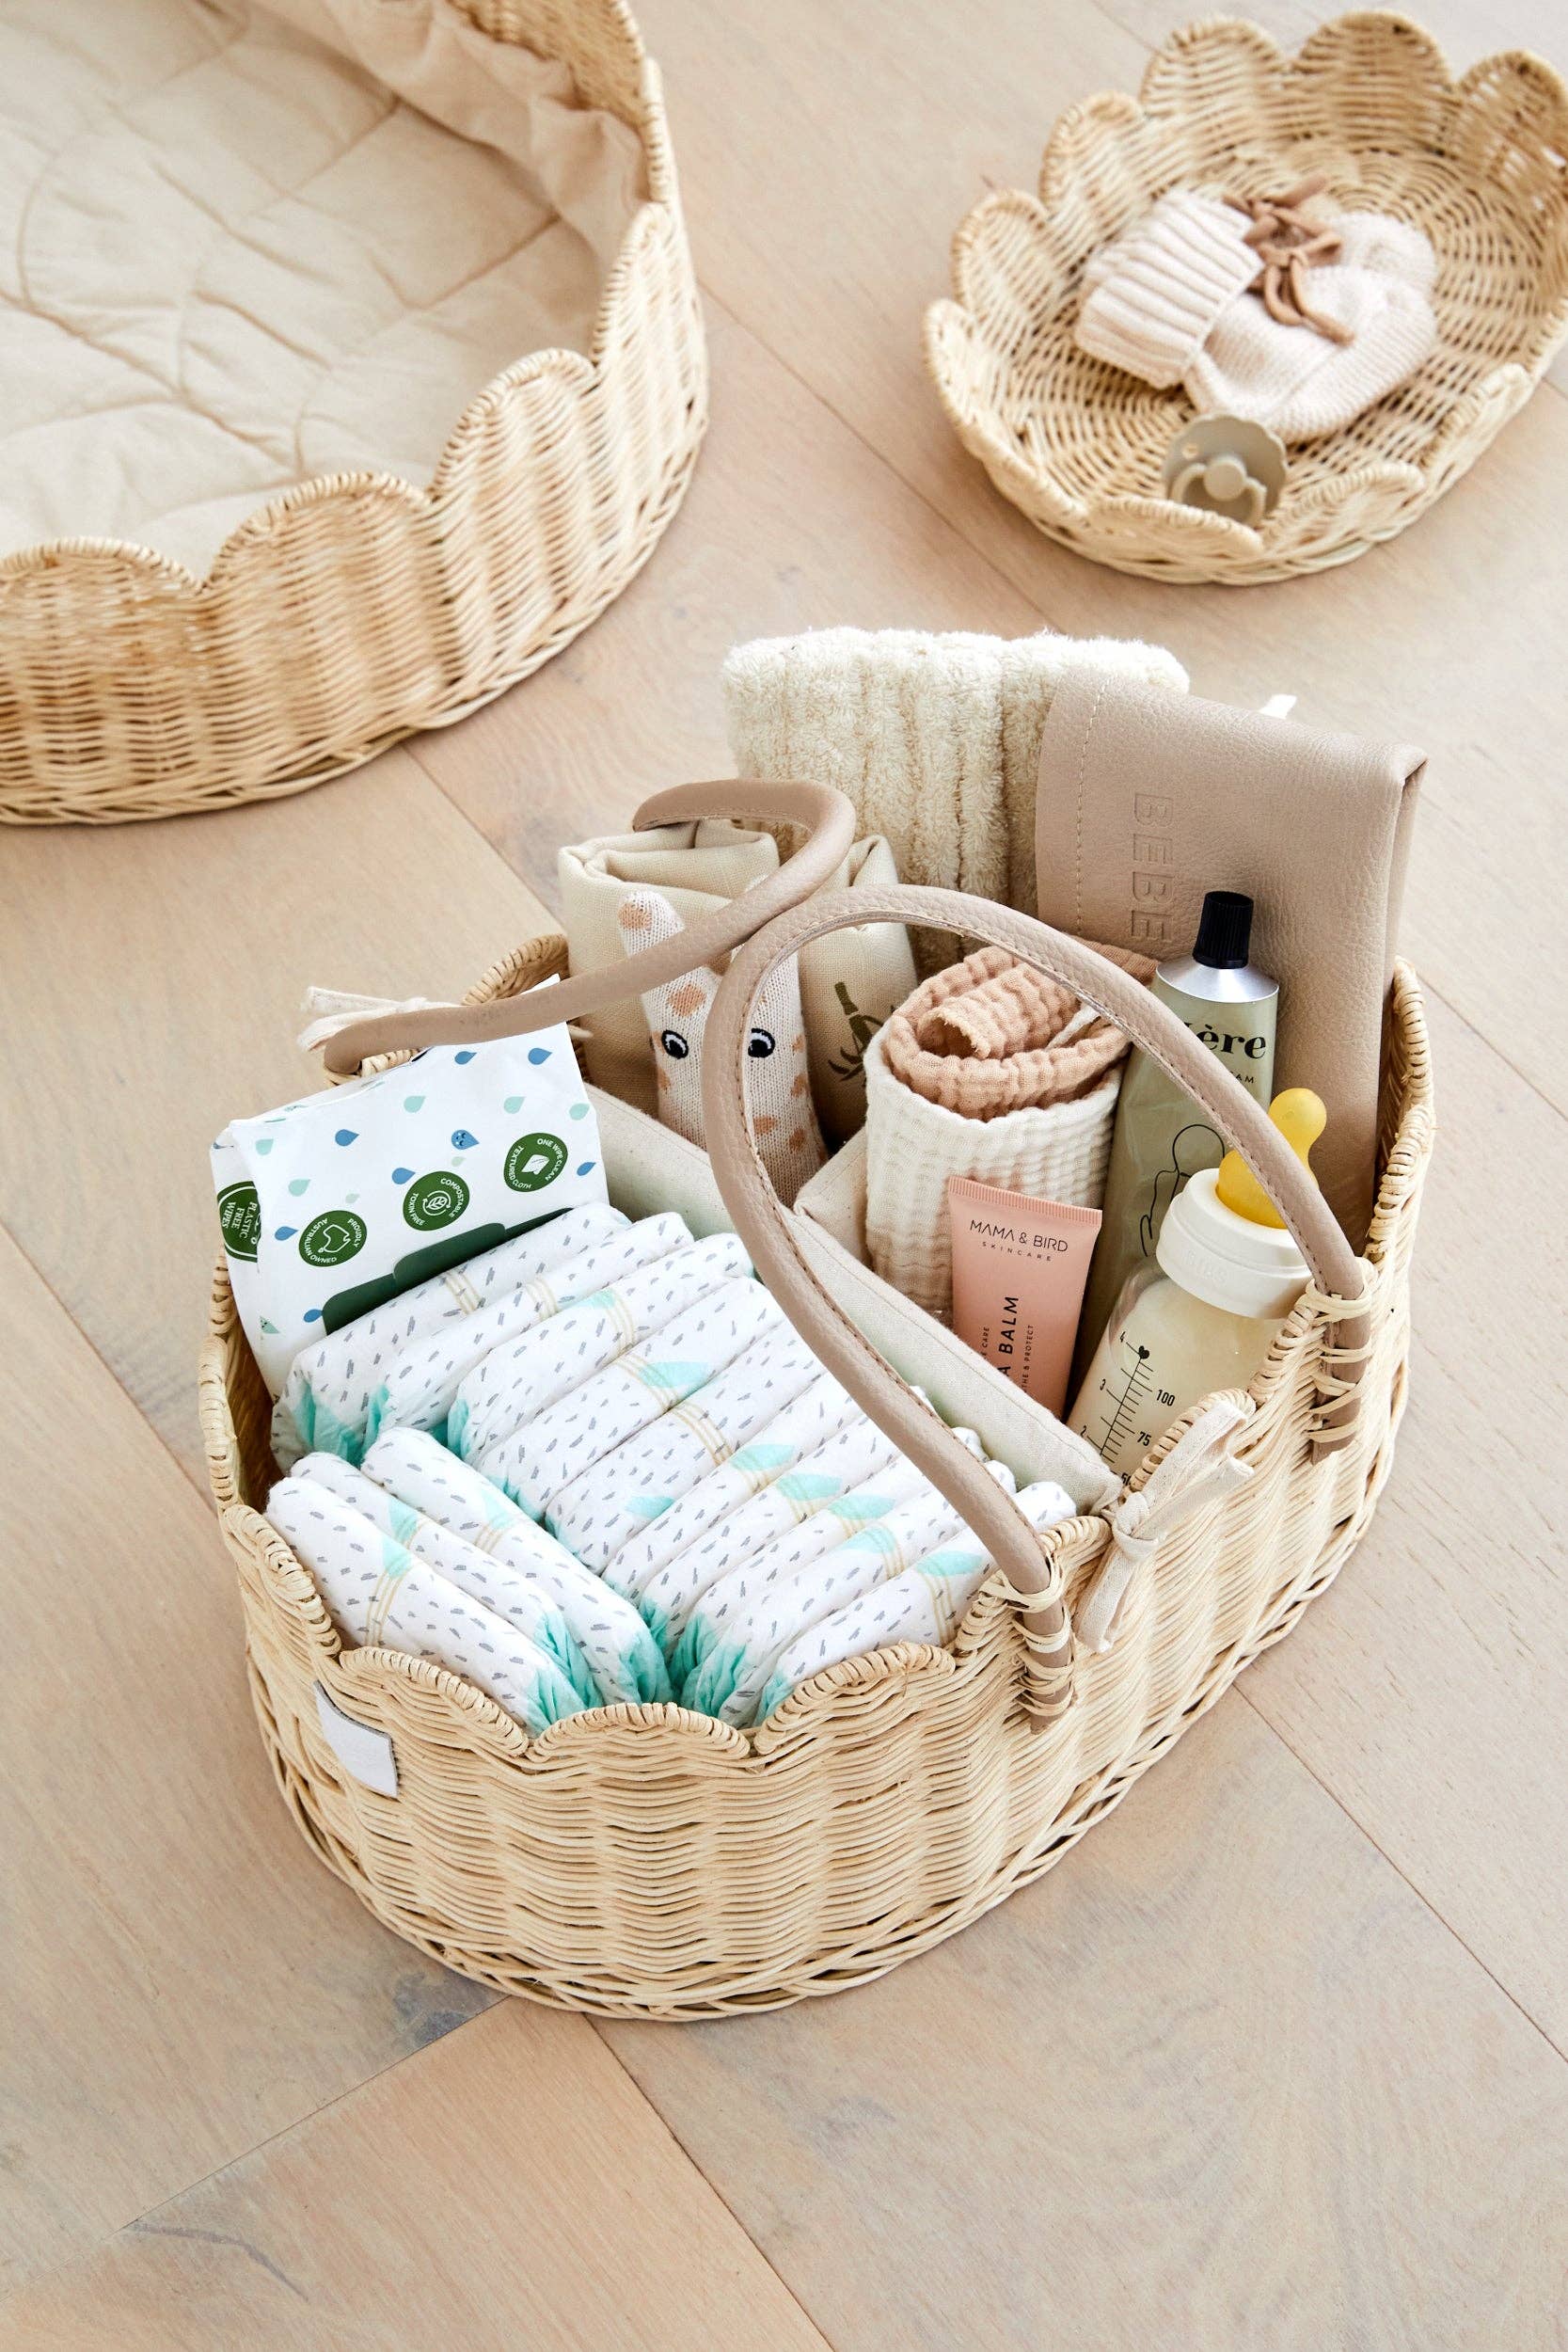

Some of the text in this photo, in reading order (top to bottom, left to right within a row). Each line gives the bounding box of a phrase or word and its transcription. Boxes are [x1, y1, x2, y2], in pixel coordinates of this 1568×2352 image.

[1131, 792, 1175, 943] BEBE
[1184, 1022, 1266, 1059] ère
[508, 1145, 532, 1189] TEXTURED CLOTH
[536, 1137, 563, 1182] ONE WIPE CLEAN
[407, 1193, 426, 1226] TOXIN FREE
[440, 1178, 464, 1218] COMPOSTABLE
[221, 1201, 237, 1229] WIPES
[230, 1207, 245, 1230] FREE
[239, 1201, 258, 1239] PLASTIC
[304, 1217, 338, 1264] AUSTRALIAN OWNED
[347, 1217, 362, 1248] PROUDLY
[969, 1219, 1069, 1252] MAMA & BIRD
[982, 1241, 1052, 1262] SKINCARE
[981, 1327, 990, 1348] CARE
[998, 1296, 1019, 1355] BALM
[1119, 1331, 1127, 1343] 4
[1023, 1325, 1034, 1362] PROTECT
[1100, 1378, 1106, 1391] 3
[1156, 1389, 1176, 1407] 100
[1080, 1424, 1087, 1438] 2
[1137, 1431, 1152, 1447] 75
